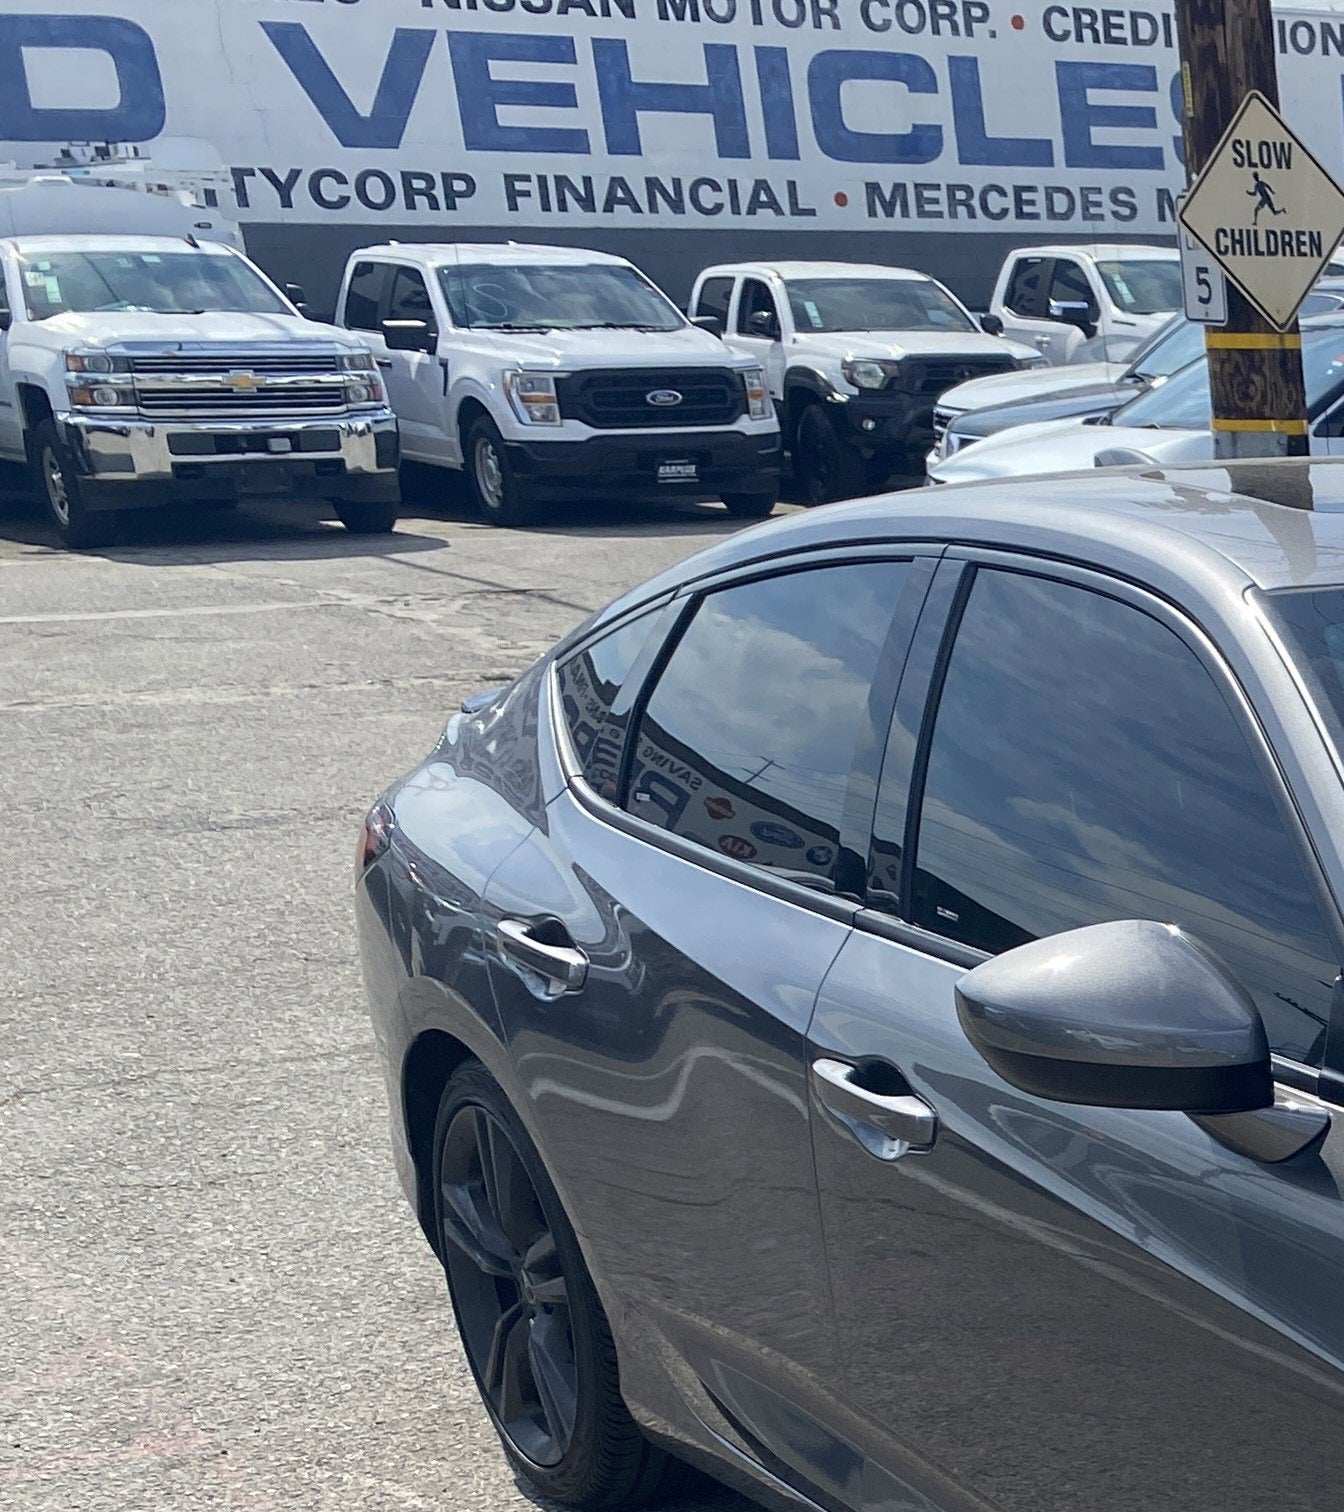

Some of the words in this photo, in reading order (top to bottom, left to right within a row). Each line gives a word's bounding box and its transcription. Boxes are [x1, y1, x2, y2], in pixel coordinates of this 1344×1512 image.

[656, 0, 841, 30] MOTOR
[860, 0, 996, 39] CORP.
[1043, 5, 1176, 48] CREDI
[1231, 138, 1292, 170] SLOW
[502, 172, 817, 217] FINANCIAL
[864, 182, 1138, 223] MERCEDES
[1214, 226, 1324, 259] CHILDREN
[1195, 266, 1213, 305] 5
